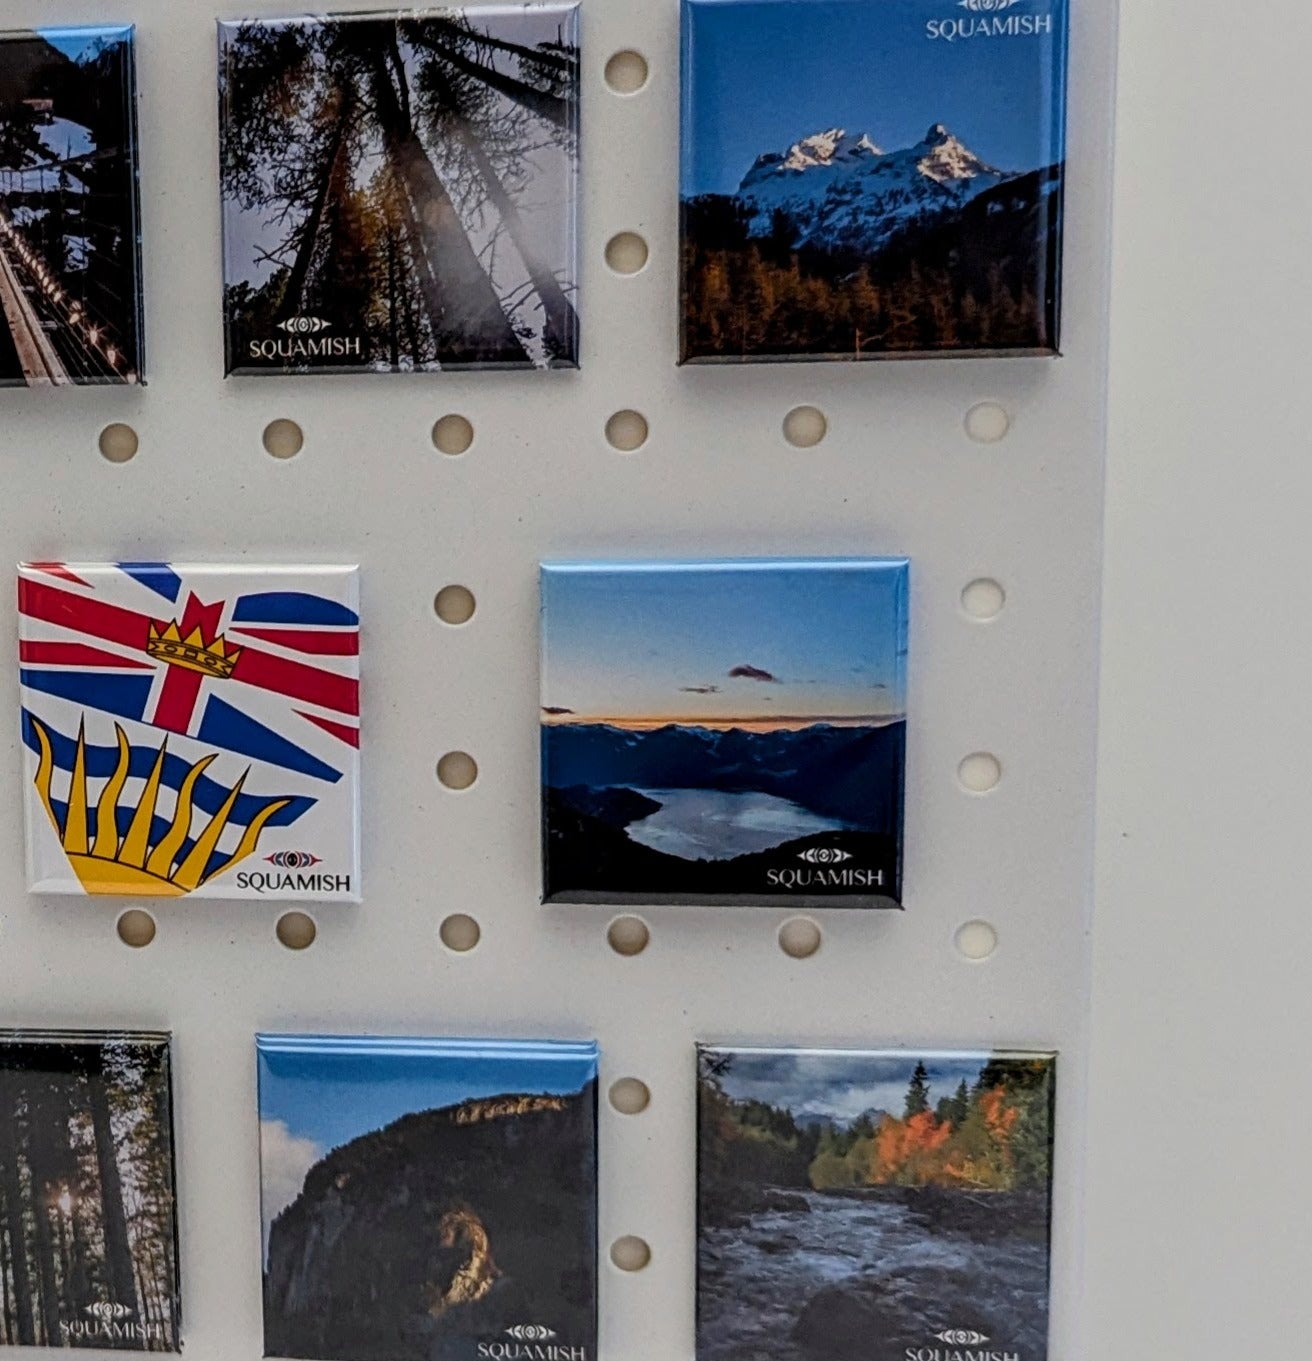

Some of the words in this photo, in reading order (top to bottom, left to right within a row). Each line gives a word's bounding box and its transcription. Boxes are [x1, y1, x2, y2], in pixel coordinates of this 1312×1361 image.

[926, 15, 1050, 40] SQUAMISH
[249, 337, 360, 359] SQUAMISH
[236, 872, 351, 893] SQUAMISH
[767, 868, 883, 887] SQUAMISH
[59, 1320, 161, 1340] SQUAMISH
[477, 1342, 585, 1361] SQUAMISH
